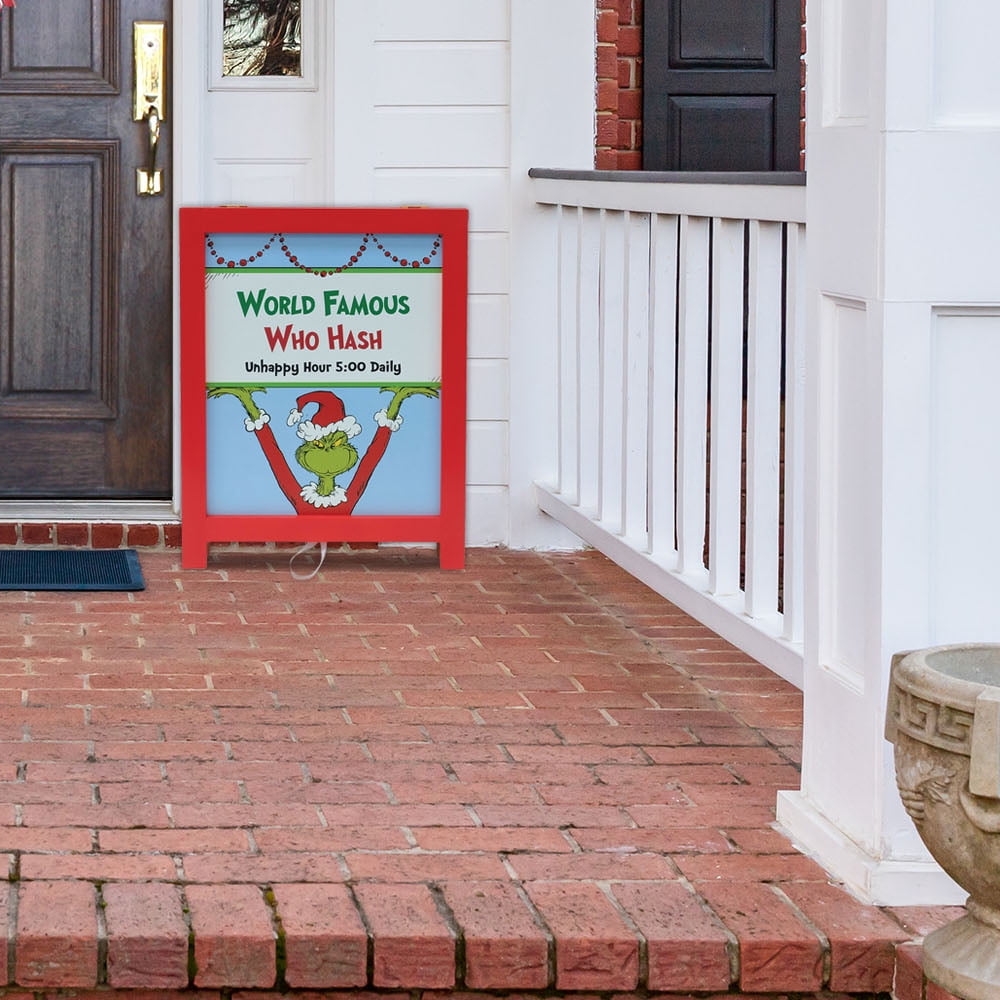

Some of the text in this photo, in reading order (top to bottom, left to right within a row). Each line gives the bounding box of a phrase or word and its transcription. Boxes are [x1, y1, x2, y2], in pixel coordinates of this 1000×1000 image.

[236, 288, 411, 318] WORLD FAMOUS
[264, 323, 383, 352] WHO HASH
[245, 359, 402, 376] Unhappy Hour 5:00 Daily
